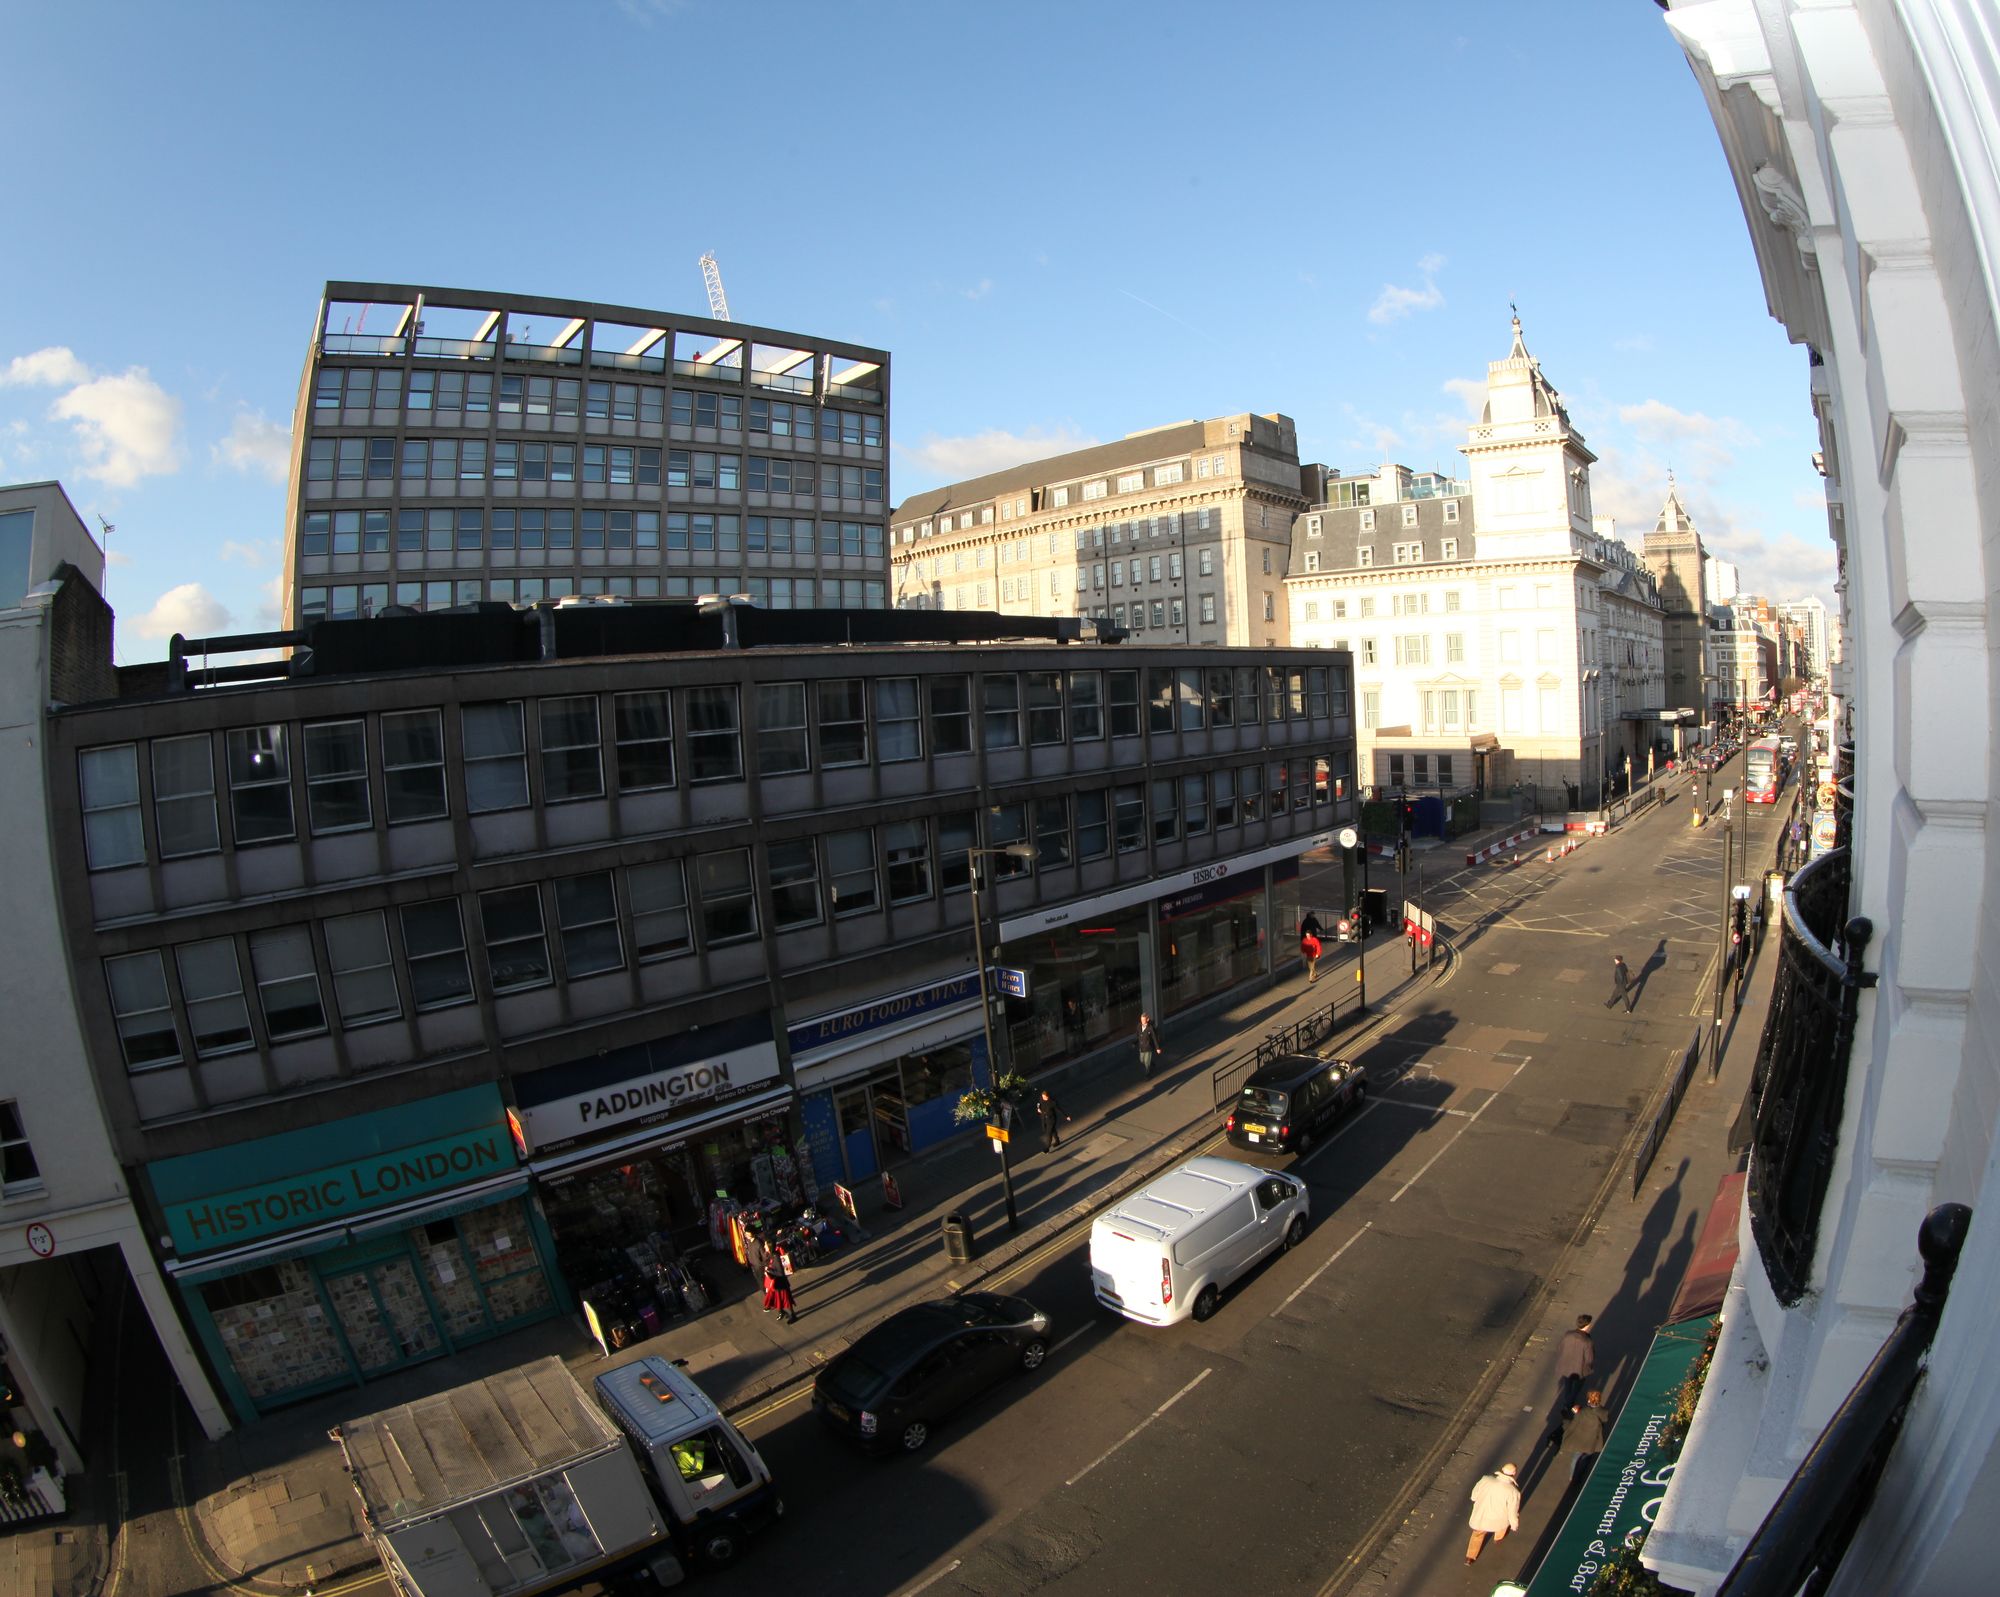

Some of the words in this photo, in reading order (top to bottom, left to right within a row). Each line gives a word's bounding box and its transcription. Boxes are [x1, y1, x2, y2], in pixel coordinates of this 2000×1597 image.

[1192, 867, 1217, 884] HSBC
[1001, 980, 1021, 993] Wines
[1002, 970, 1020, 982] Beers
[819, 1013, 865, 1038] EURO
[868, 997, 912, 1023] FOOD
[915, 995, 927, 1009] &
[930, 979, 969, 1003] WINE
[579, 1061, 730, 1123] PADDINGTON
[542, 1138, 576, 1153] Souvenirs
[639, 1110, 670, 1126] Luggage
[714, 1090, 736, 1103] Bureau
[737, 1087, 746, 1096] De
[747, 1079, 772, 1093] Change
[660, 1139, 687, 1153] Luggage
[744, 1114, 762, 1125] Bureau
[769, 1104, 791, 1117] Change
[186, 1181, 346, 1241] HISTORIC
[351, 1137, 499, 1200] LONDON
[1634, 1413, 1667, 1457] Italian
[1596, 1458, 1646, 1535] Restaurant
[1583, 1539, 1606, 1557] &
[1569, 1560, 1598, 1594] Bar
